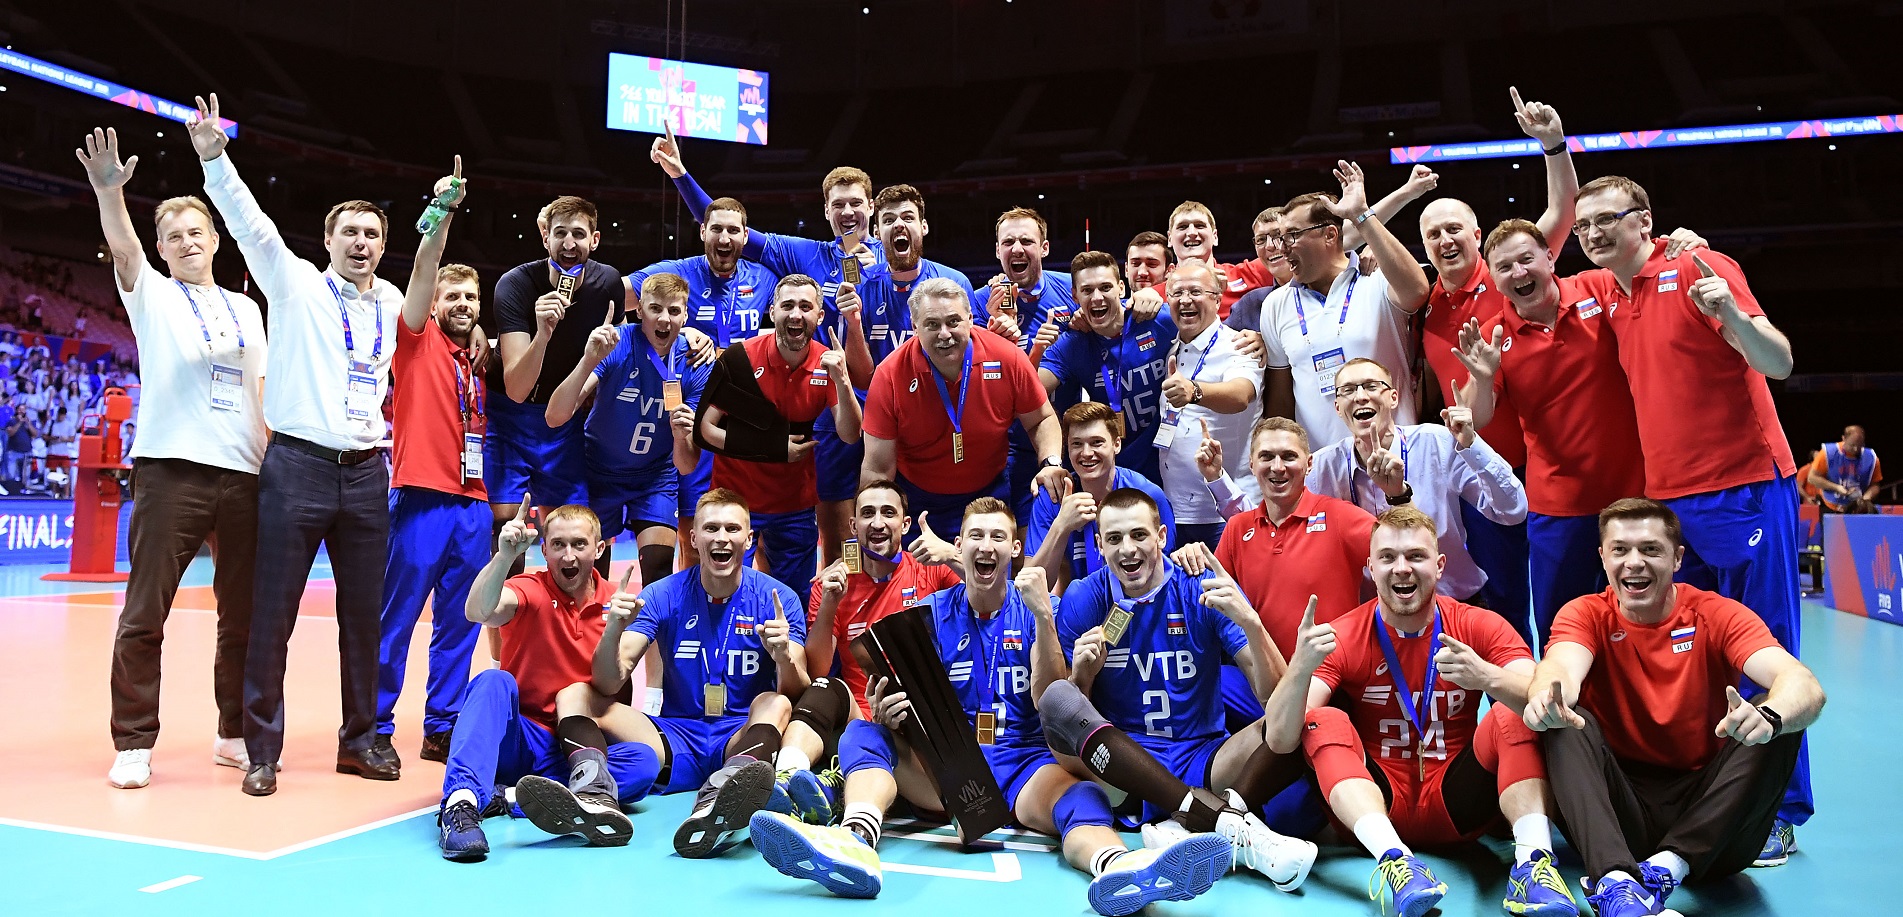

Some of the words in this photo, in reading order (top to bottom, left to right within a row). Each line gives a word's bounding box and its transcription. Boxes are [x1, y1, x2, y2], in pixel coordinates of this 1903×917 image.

[623, 101, 640, 124] IN
[1122, 390, 1158, 433] 15
[629, 422, 656, 454] 6
[997, 665, 1031, 695] TB
[1132, 650, 1197, 681] VTB
[1142, 690, 1173, 738] 2
[1395, 689, 1466, 722] VTB
[1379, 718, 1448, 760] 24
